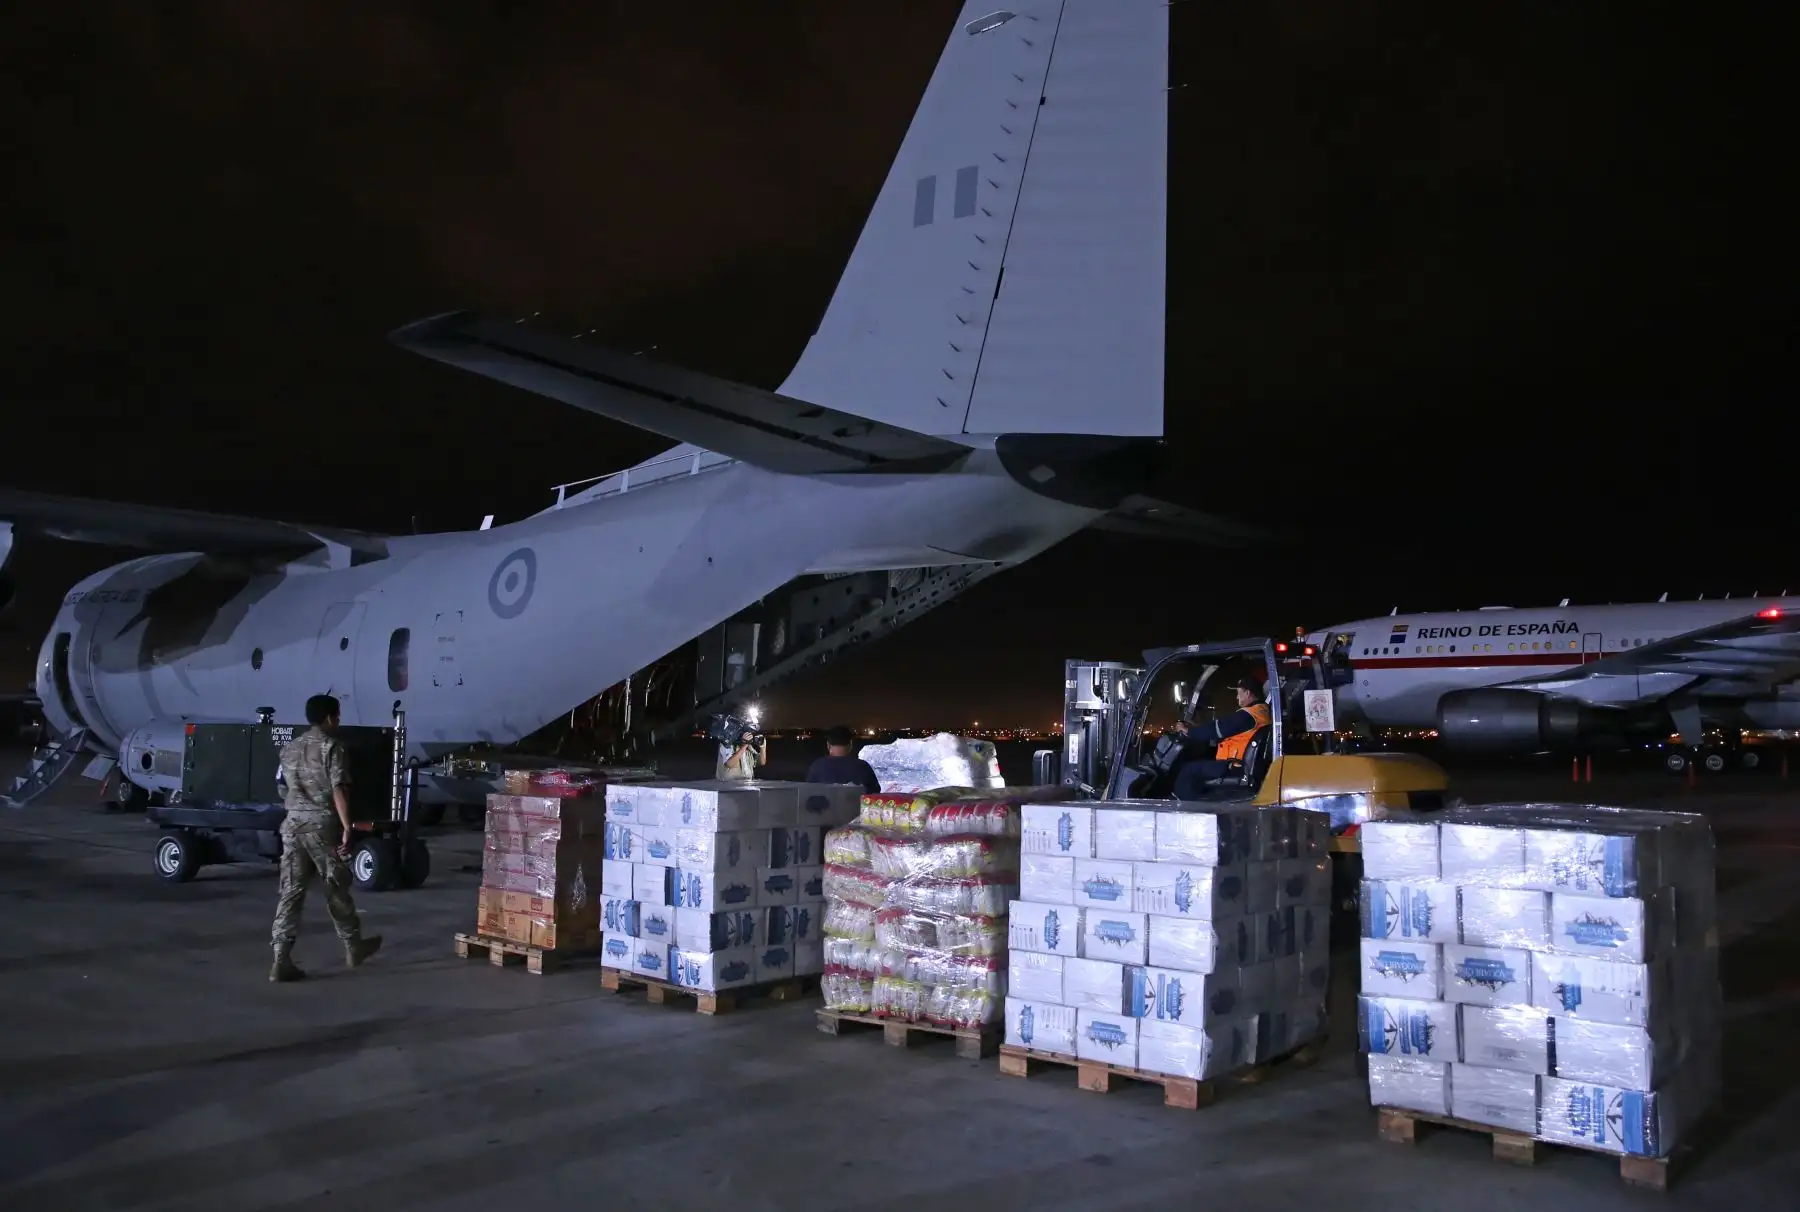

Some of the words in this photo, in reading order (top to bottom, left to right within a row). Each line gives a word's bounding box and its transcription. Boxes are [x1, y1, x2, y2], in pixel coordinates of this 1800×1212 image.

[1417, 625, 1472, 640] REINO
[1478, 625, 1502, 637] DE
[1506, 620, 1580, 636] ESPAÑA
